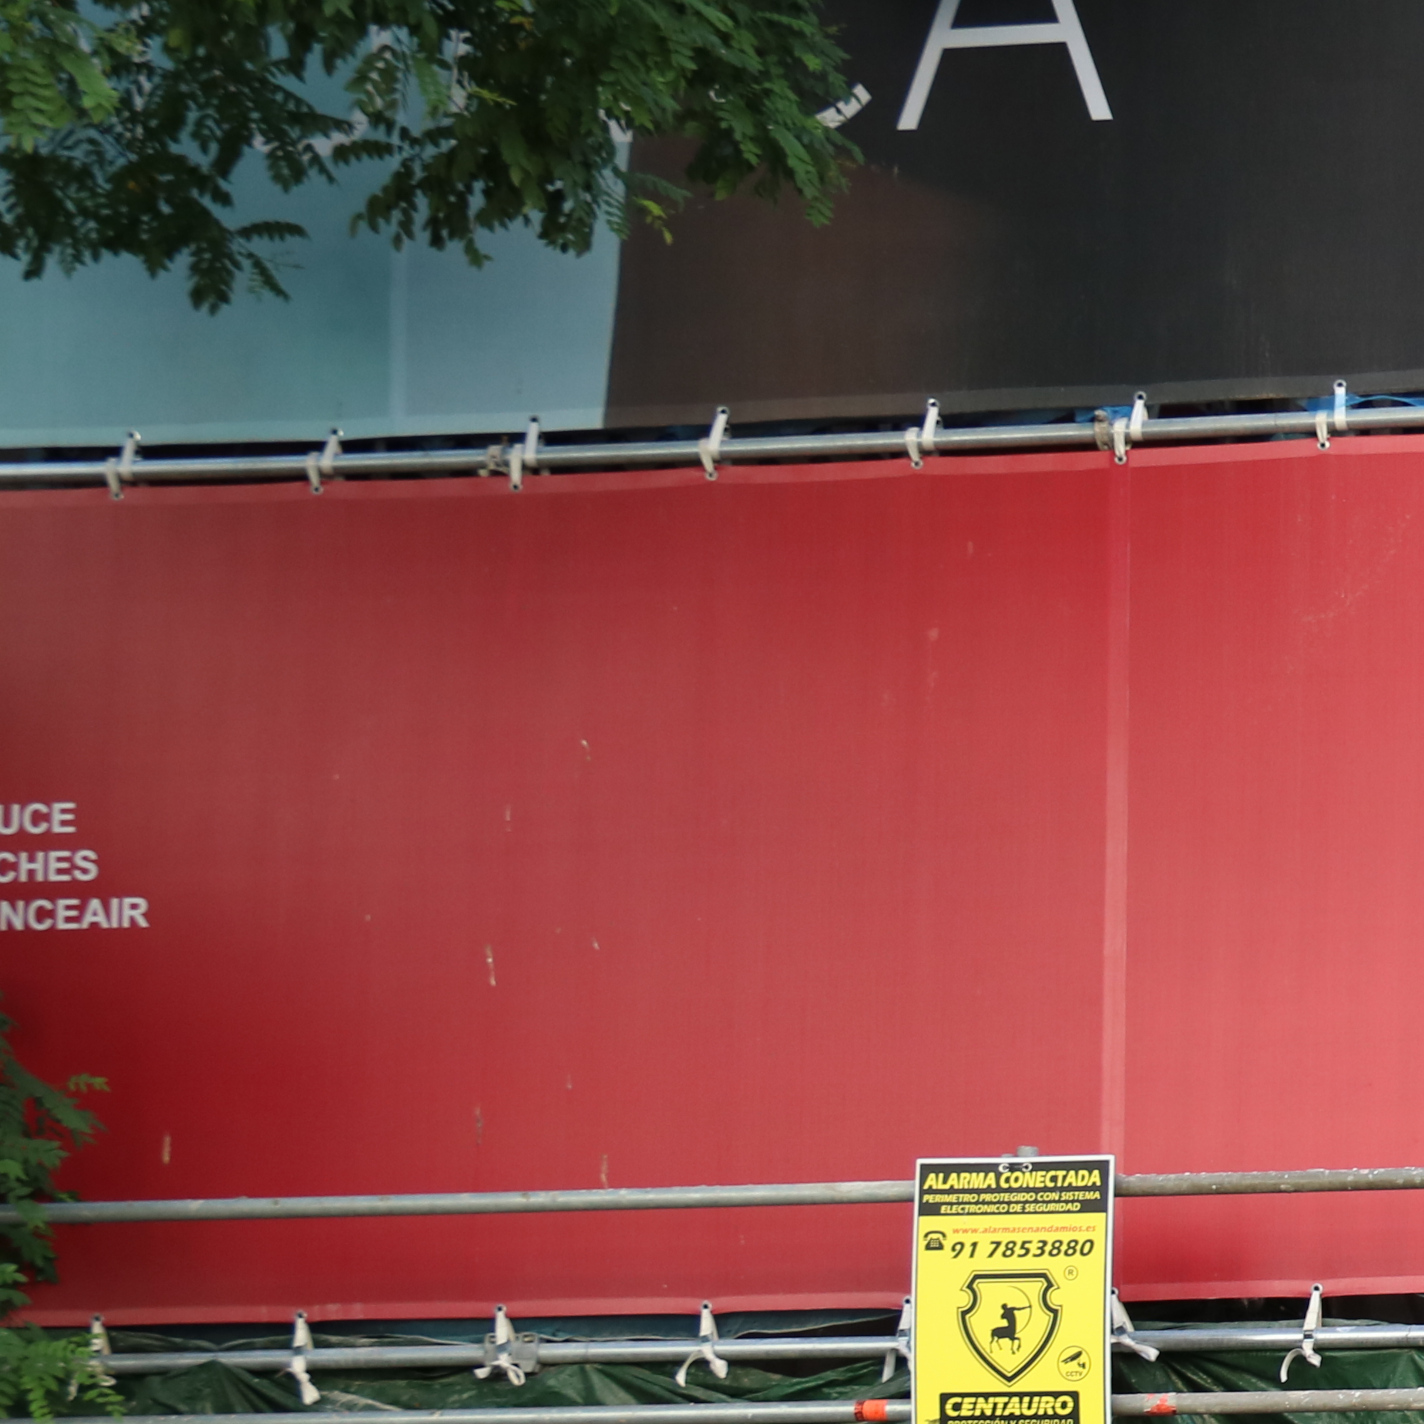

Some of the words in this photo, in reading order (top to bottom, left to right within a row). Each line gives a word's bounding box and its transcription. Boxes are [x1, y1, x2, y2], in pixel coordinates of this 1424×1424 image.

[0, 802, 77, 835] UCE
[0, 897, 150, 931] NCEAIR
[923, 1172, 996, 1190] ALARMA
[1000, 1169, 1101, 1188] CONECTADA
[922, 1193, 978, 1203] PERIMETRO
[979, 1192, 1035, 1202] PROTEGIDO
[1037, 1191, 1059, 1201] CON
[1060, 1191, 1101, 1200] SISTEMA
[940, 1203, 1008, 1214] ELECTRONICO
[1009, 1203, 1023, 1212] DE
[1024, 1202, 1081, 1212] SEGURIDAD
[952, 1224, 1096, 1235] www.alarmasenandamios.es
[951, 1241, 979, 1259] 91
[987, 1239, 1095, 1258] 7853880
[944, 1395, 1074, 1417] CENTAURO
